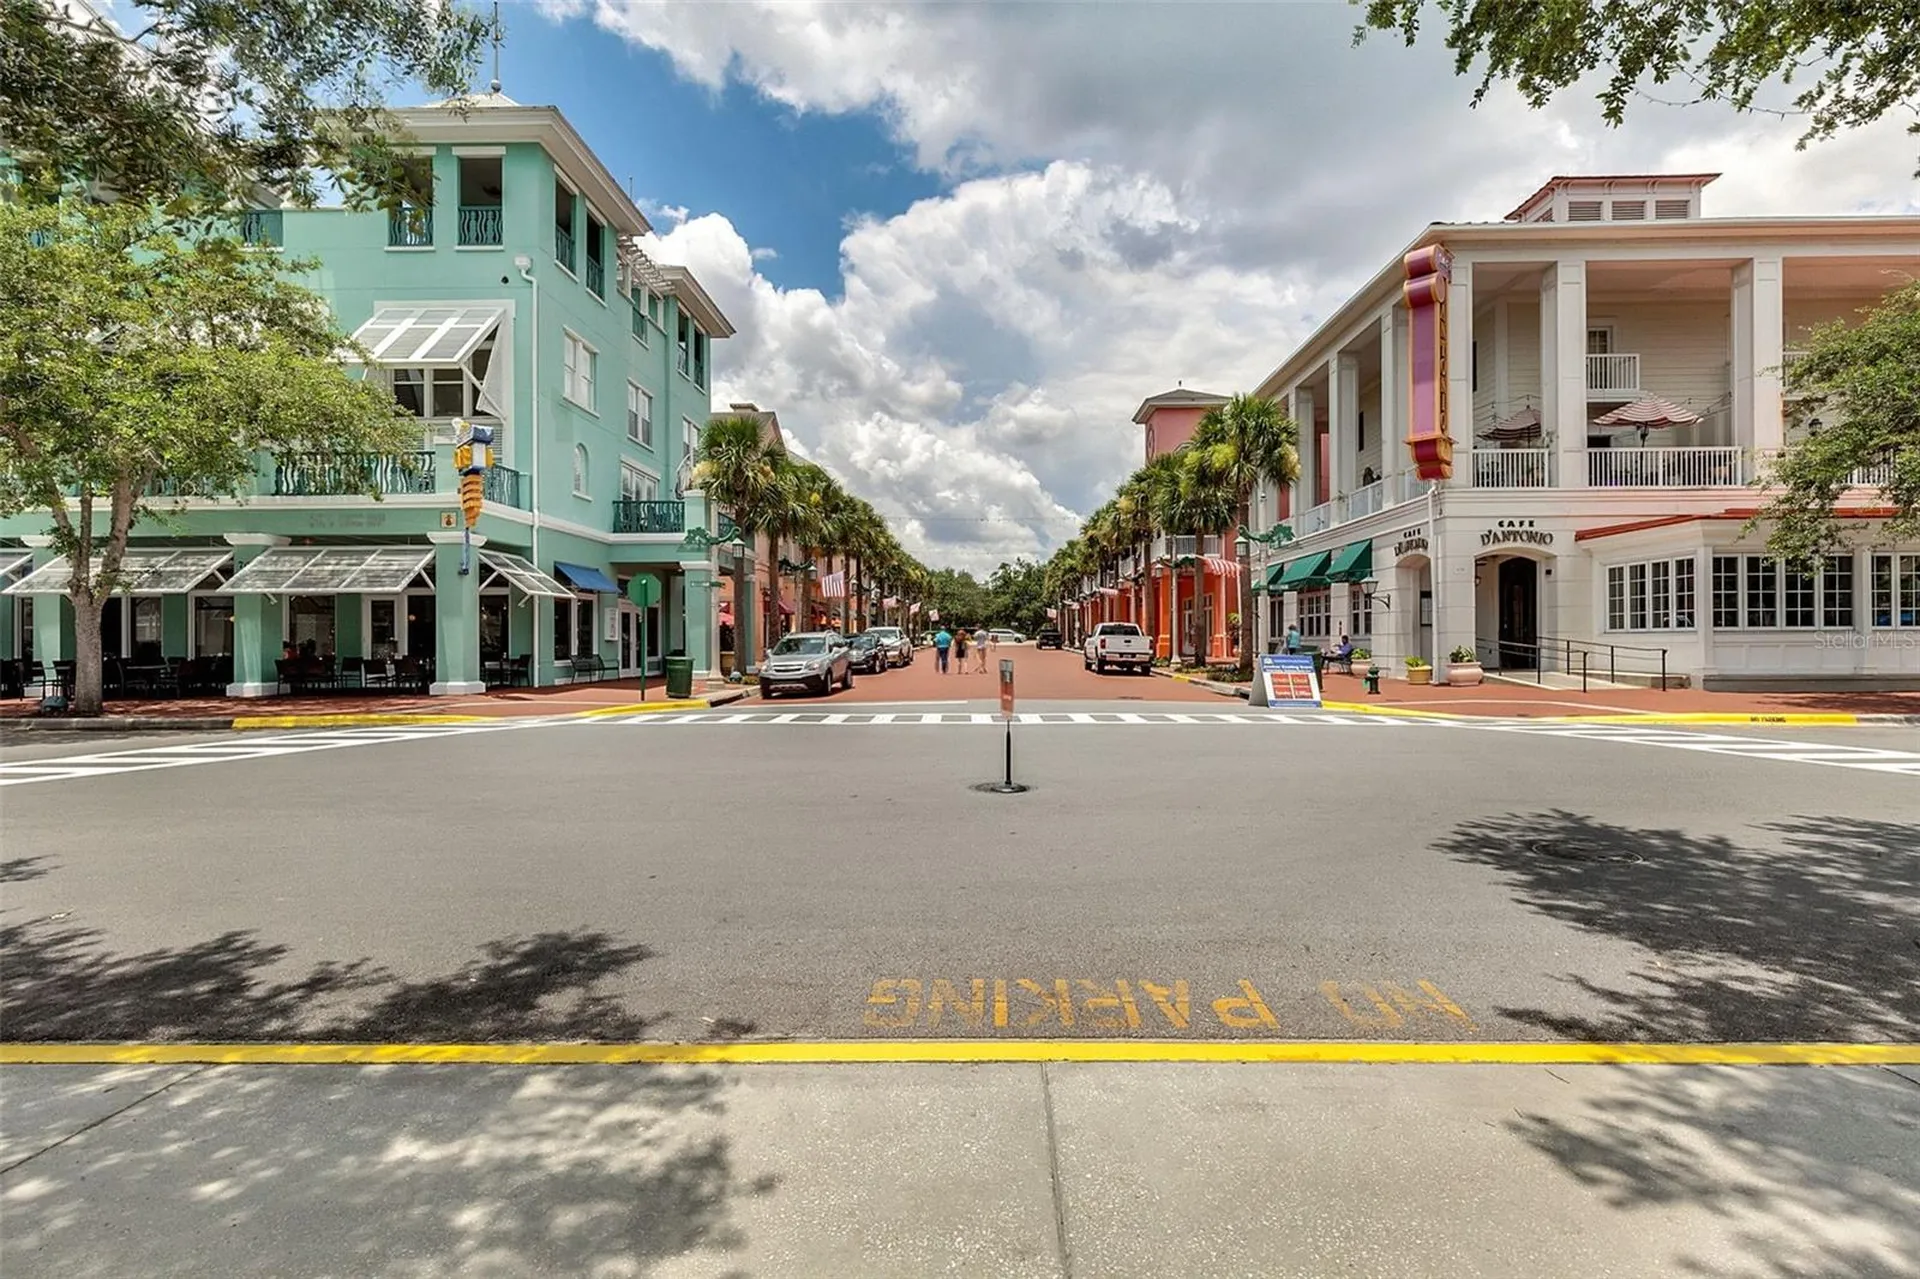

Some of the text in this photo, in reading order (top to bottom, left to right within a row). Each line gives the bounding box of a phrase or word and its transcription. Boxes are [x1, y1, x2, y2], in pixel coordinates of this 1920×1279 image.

[1498, 520, 1535, 528] CAFE
[1403, 528, 1421, 539] CAFE
[1480, 529, 1554, 546] D'ANTONIO
[863, 978, 1479, 1031] NO PARKING
